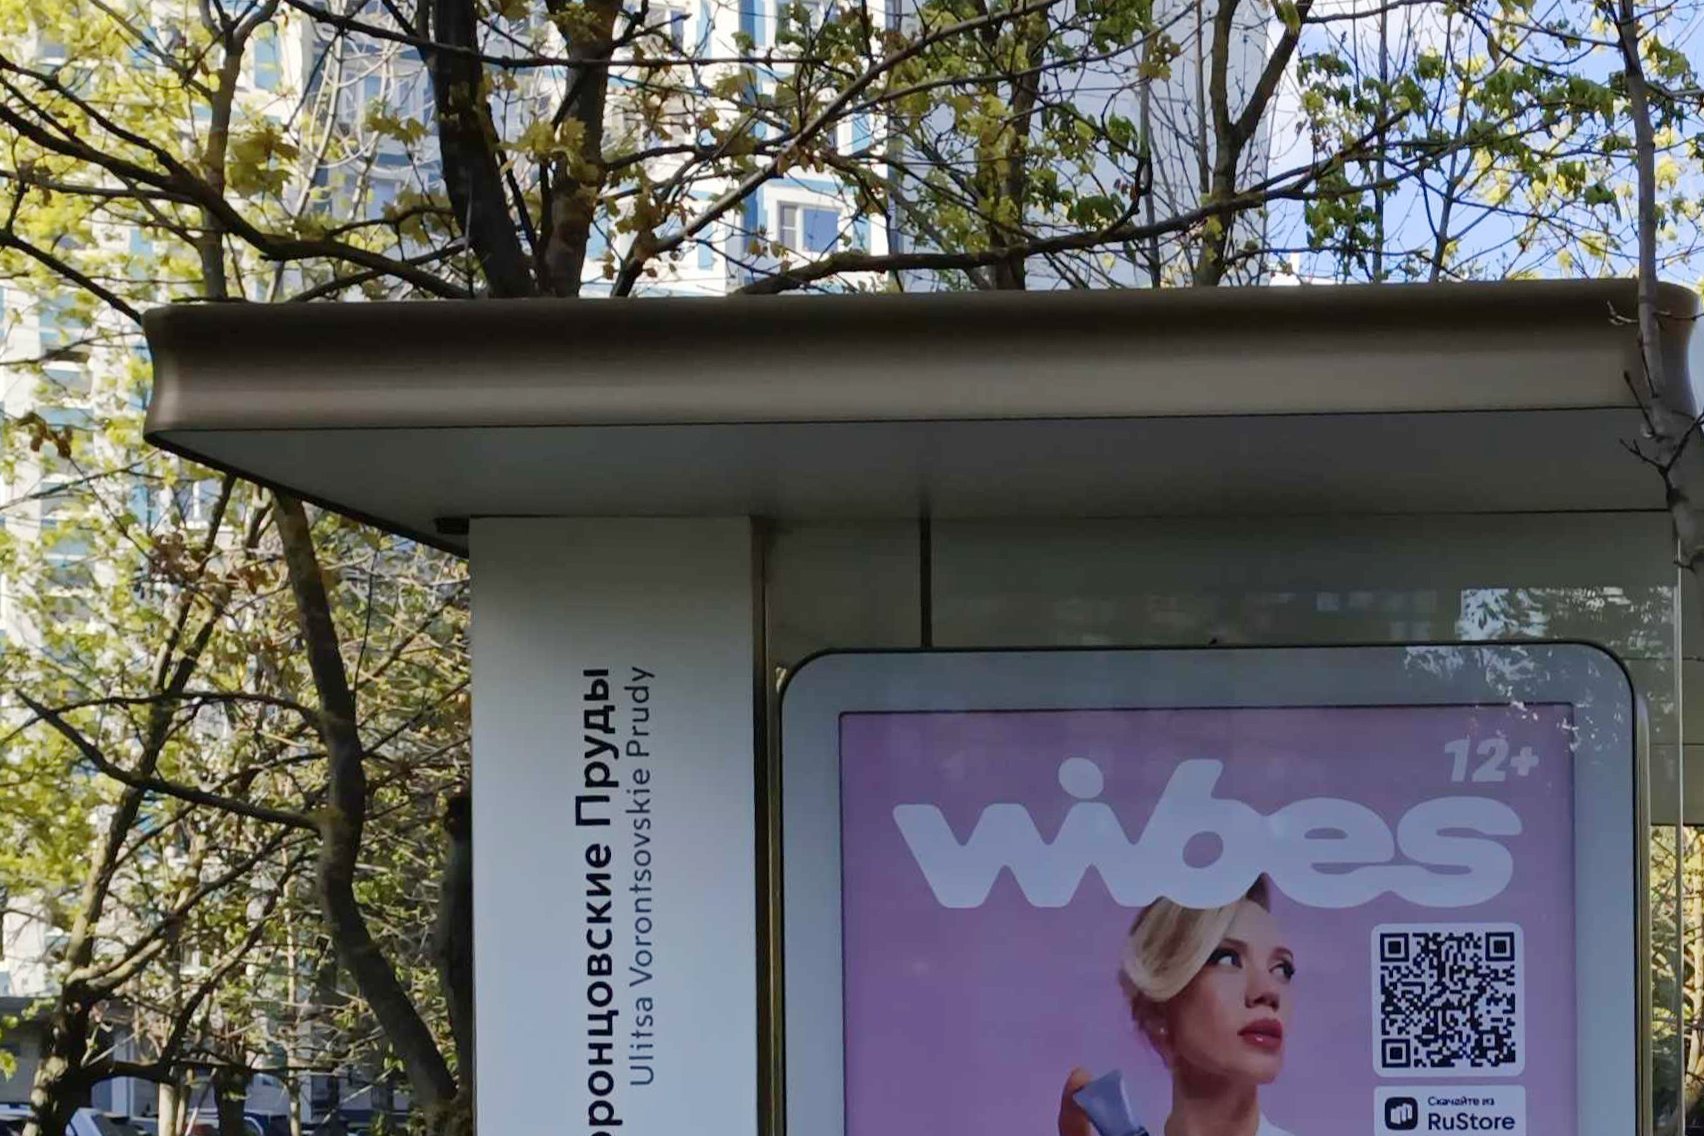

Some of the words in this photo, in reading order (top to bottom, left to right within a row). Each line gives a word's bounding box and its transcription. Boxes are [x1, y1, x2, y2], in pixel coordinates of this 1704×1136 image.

[575, 668, 619, 826] Пруды
[624, 666, 655, 756] Prudy
[1443, 737, 1540, 784] 12+
[626, 767, 654, 987] Vorontsovskie
[629, 997, 654, 1085] Ulitsa
[1428, 1095, 1480, 1106] Скачайте
[1482, 1096, 1495, 1106] из
[1429, 1113, 1515, 1130] RuStore
